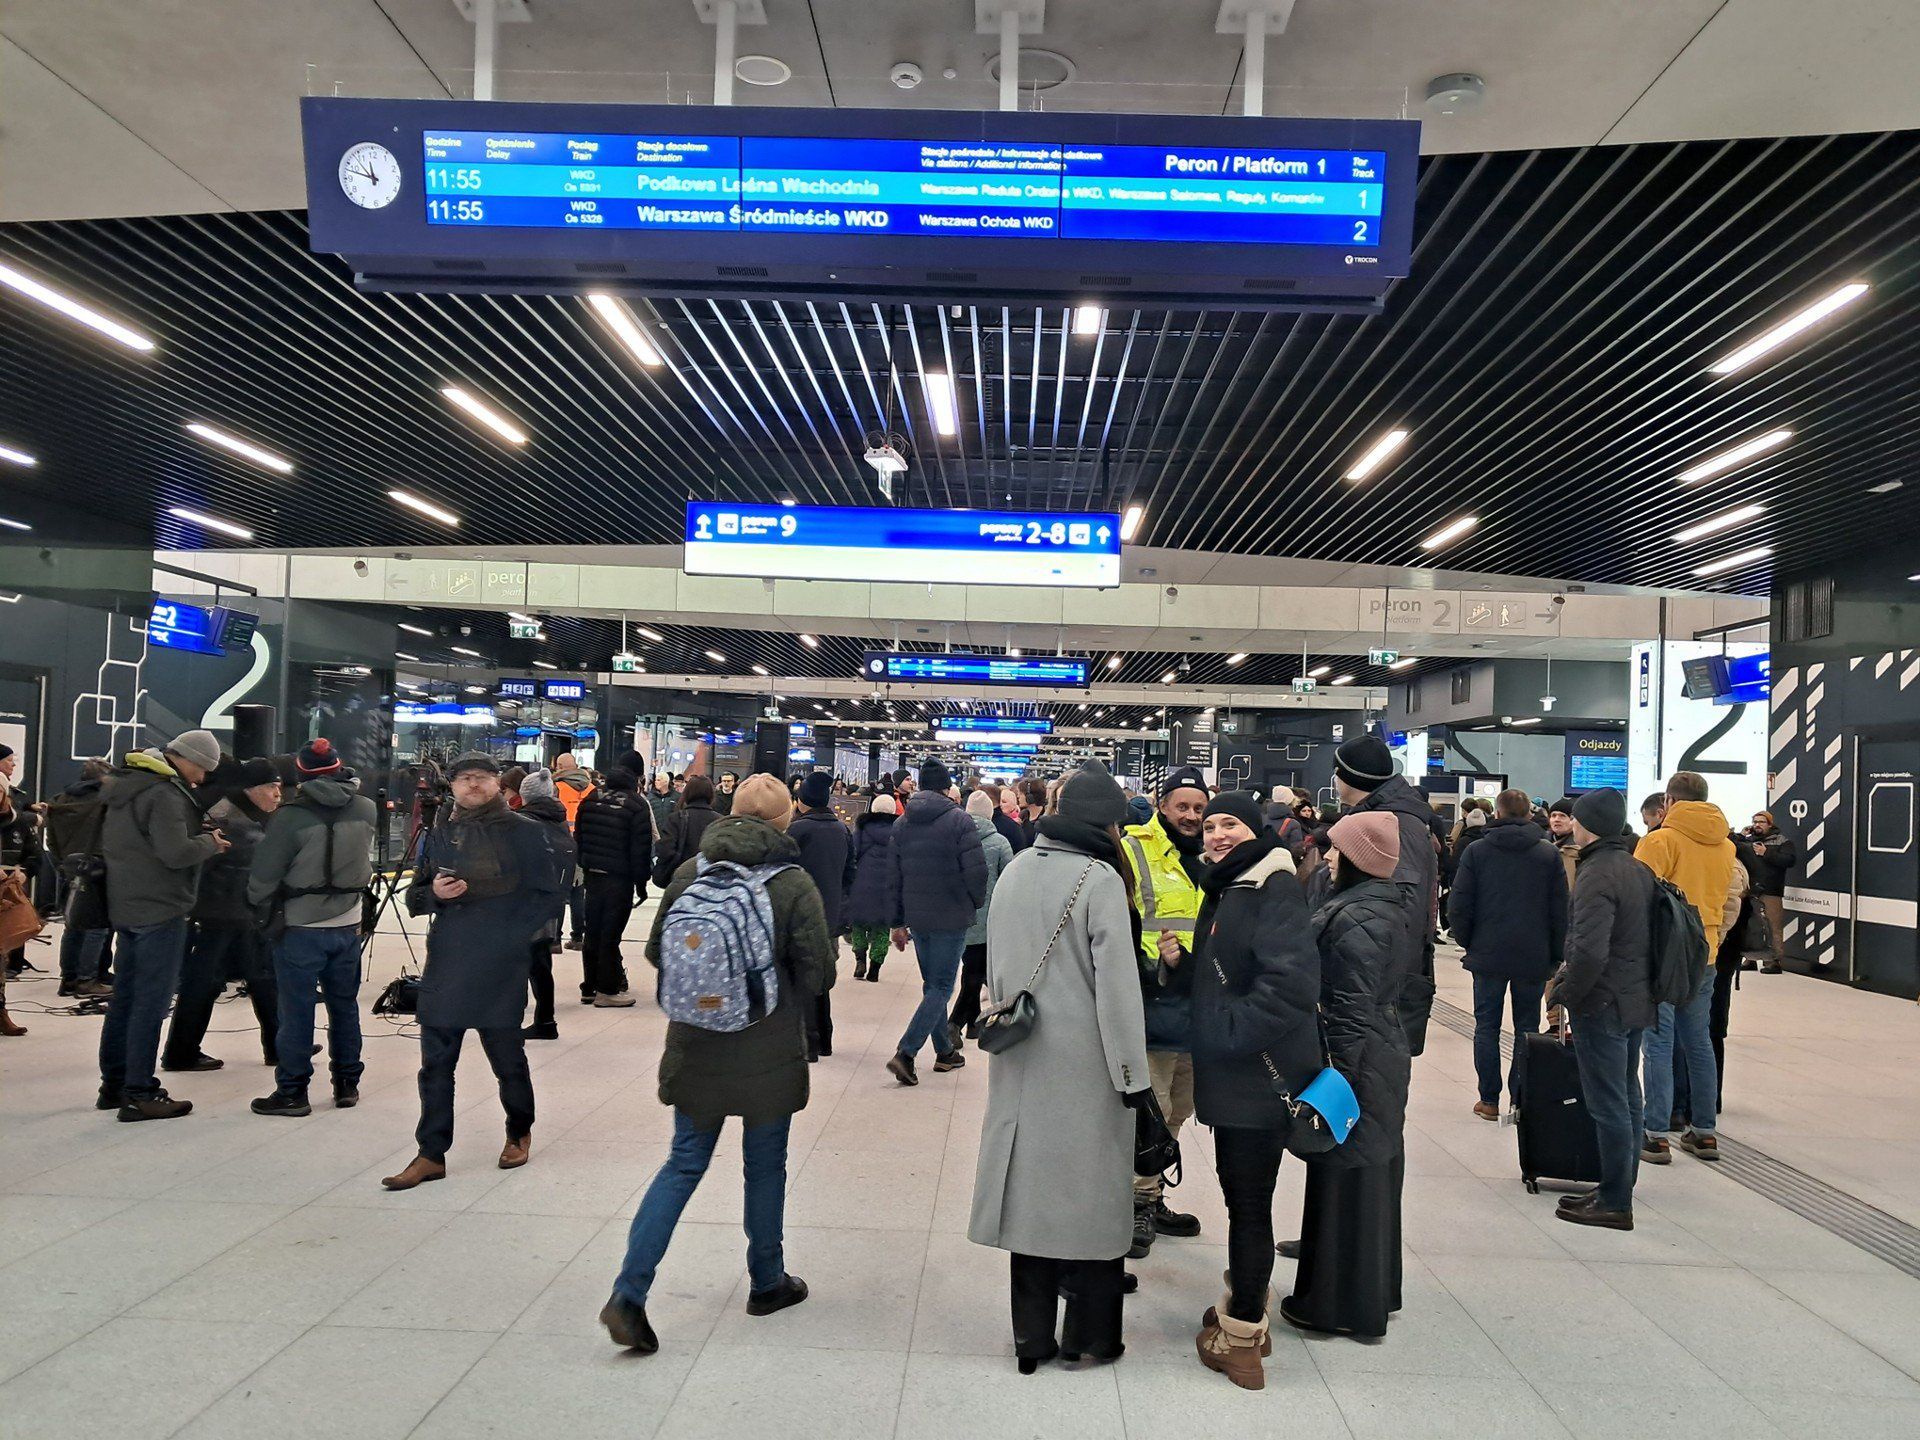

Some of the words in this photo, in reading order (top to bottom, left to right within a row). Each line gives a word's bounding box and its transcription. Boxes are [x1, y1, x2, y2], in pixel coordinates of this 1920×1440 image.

[486, 149, 511, 160] Delay
[572, 151, 592, 161] Train
[637, 152, 683, 162] Destination
[936, 159, 968, 168] stations
[975, 160, 1016, 170] Additional
[1165, 154, 1218, 173] Peron
[1222, 155, 1229, 173] /
[1233, 156, 1309, 175] Platform
[1317, 158, 1326, 175] 1
[1352, 168, 1375, 178] Track
[427, 169, 482, 189] 11:55
[569, 170, 596, 180] WKD
[637, 174, 717, 192] Podkowa
[782, 177, 880, 195] Wschodnia
[570, 201, 596, 211] WKD
[1358, 190, 1368, 209] 1
[429, 200, 484, 221] 11:55
[637, 205, 725, 223] Warszawa
[729, 204, 841, 227] Śródmieście
[844, 209, 889, 227] WKD
[919, 213, 977, 227] Warszawa
[980, 214, 1021, 228] Ochota
[1023, 216, 1053, 229] WKD
[1353, 221, 1368, 241] 2
[780, 514, 797, 538] 9
[1026, 521, 1066, 545] 2-8
[1370, 600, 1421, 614] peron
[1432, 599, 1451, 627] 2
[1579, 739, 1622, 751] Odjazdy
